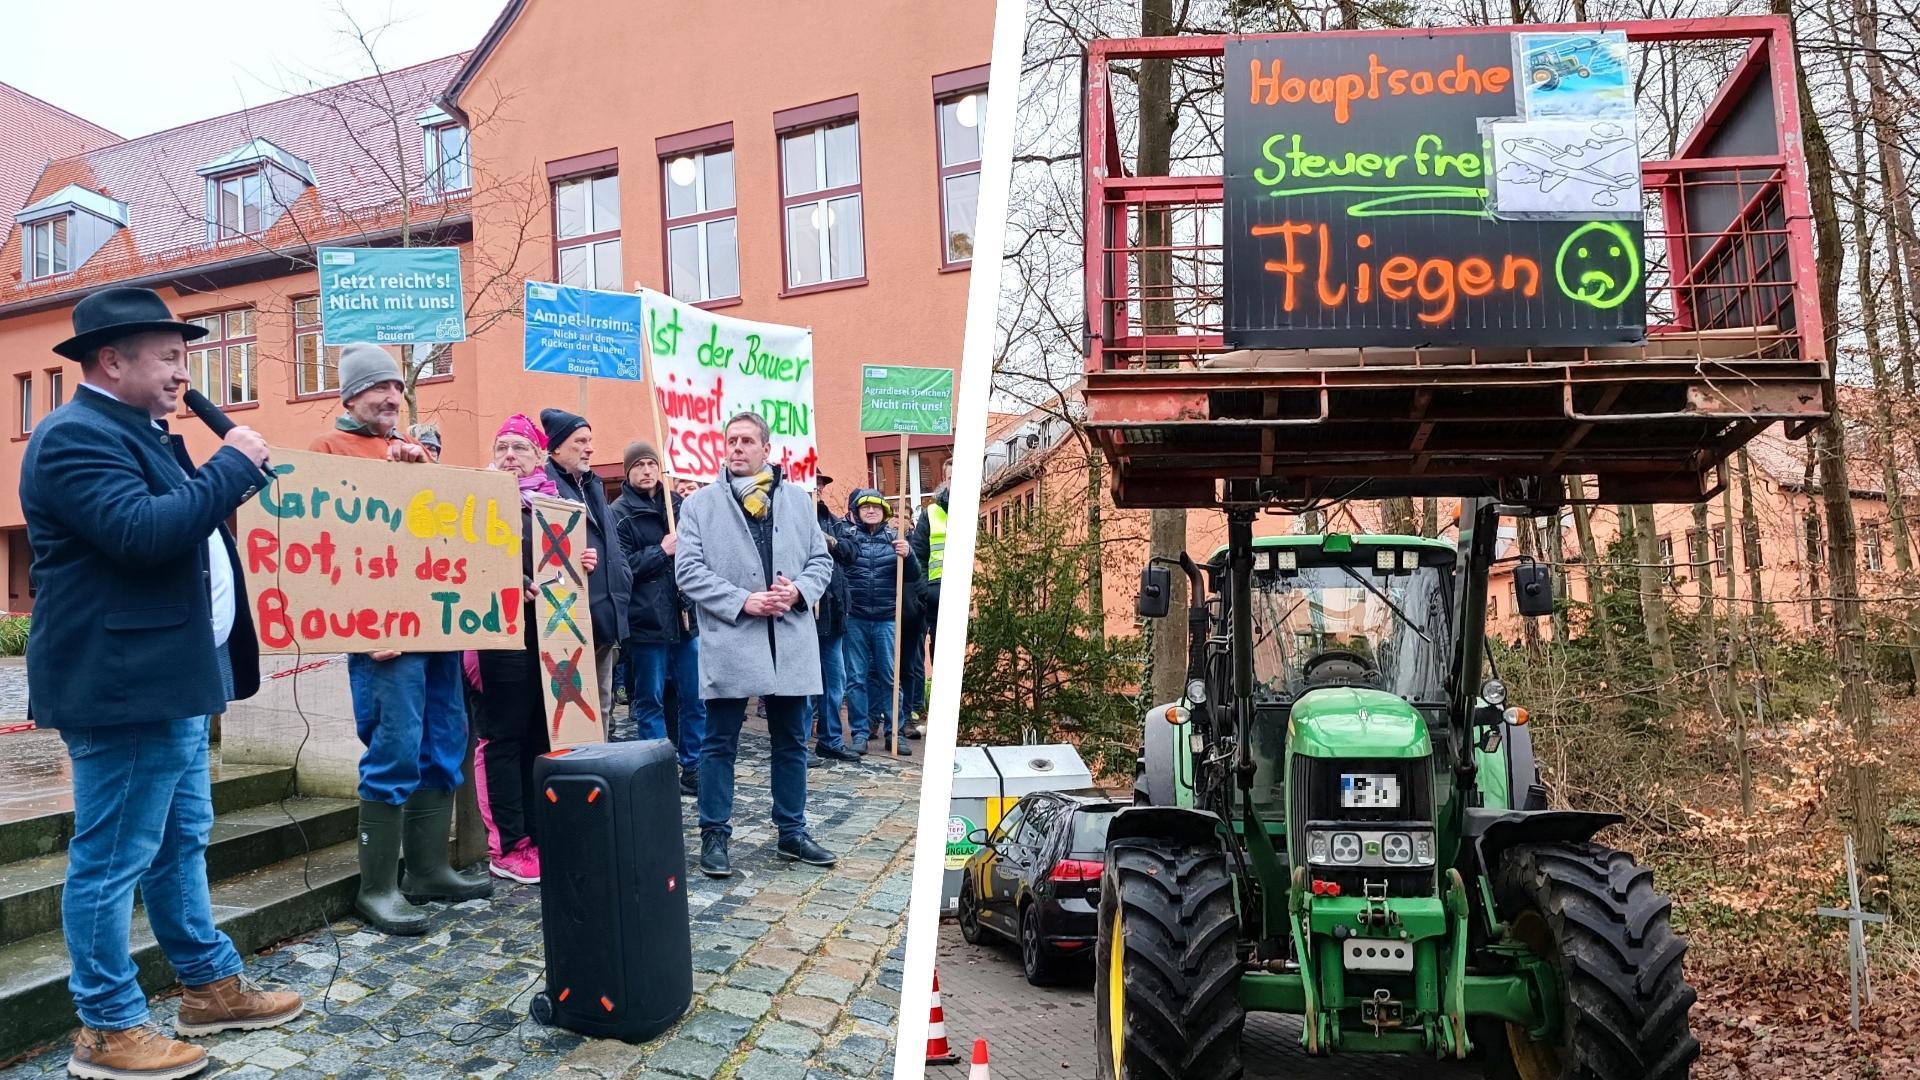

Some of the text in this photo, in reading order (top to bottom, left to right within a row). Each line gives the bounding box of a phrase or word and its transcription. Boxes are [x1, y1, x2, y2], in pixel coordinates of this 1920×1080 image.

[331, 273, 376, 288] Jetzt
[1251, 220, 1540, 324] Fliegen
[330, 293, 455, 310] Nicht mit uns!
[534, 308, 633, 332] Ampel-Irrsinn:
[376, 331, 414, 340] Bauern
[554, 330, 614, 344] Nicht auf dem
[542, 338, 626, 355] Rücken der Bauern!
[650, 308, 810, 382] Ist der Bauer
[568, 364, 599, 374] Bauern
[865, 386, 950, 398] Agrardiesel streichen?
[656, 374, 724, 424] ruiniert
[760, 400, 808, 436] DEIN
[872, 399, 943, 411] Nicht mit uns!
[894, 422, 918, 431] Bauern
[669, 427, 726, 477] ESSE
[259, 464, 520, 558] Grün, Gelb,
[247, 528, 468, 586] Rot, ist des
[257, 587, 520, 648] Bauern Tod!
